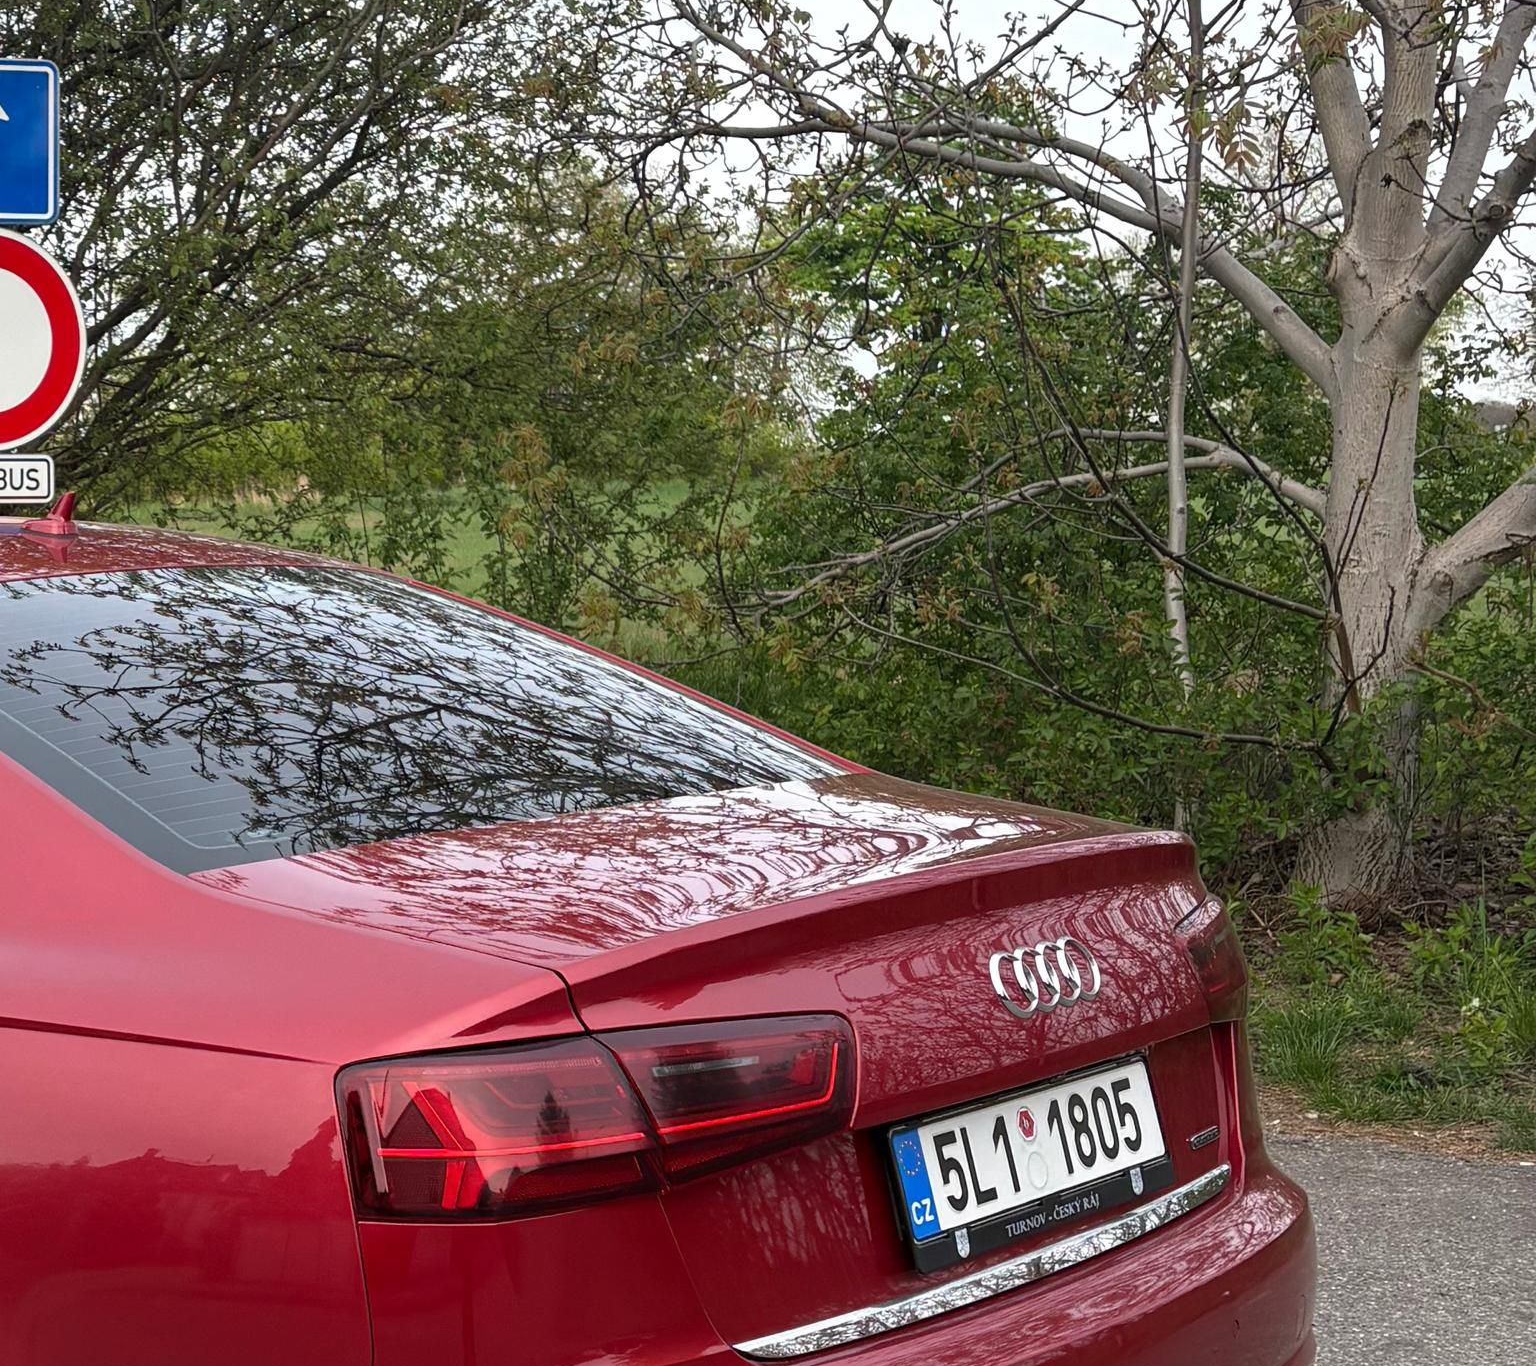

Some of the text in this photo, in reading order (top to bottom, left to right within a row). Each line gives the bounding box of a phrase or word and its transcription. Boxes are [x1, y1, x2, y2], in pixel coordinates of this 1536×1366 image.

[932, 1077, 1142, 1212] 5L1 1805
[911, 1197, 935, 1226] CZ
[1005, 1212, 1046, 1238] TURNOV
[1053, 1196, 1081, 1220] ČESKÝ
[1082, 1191, 1100, 1210] RÁJ
